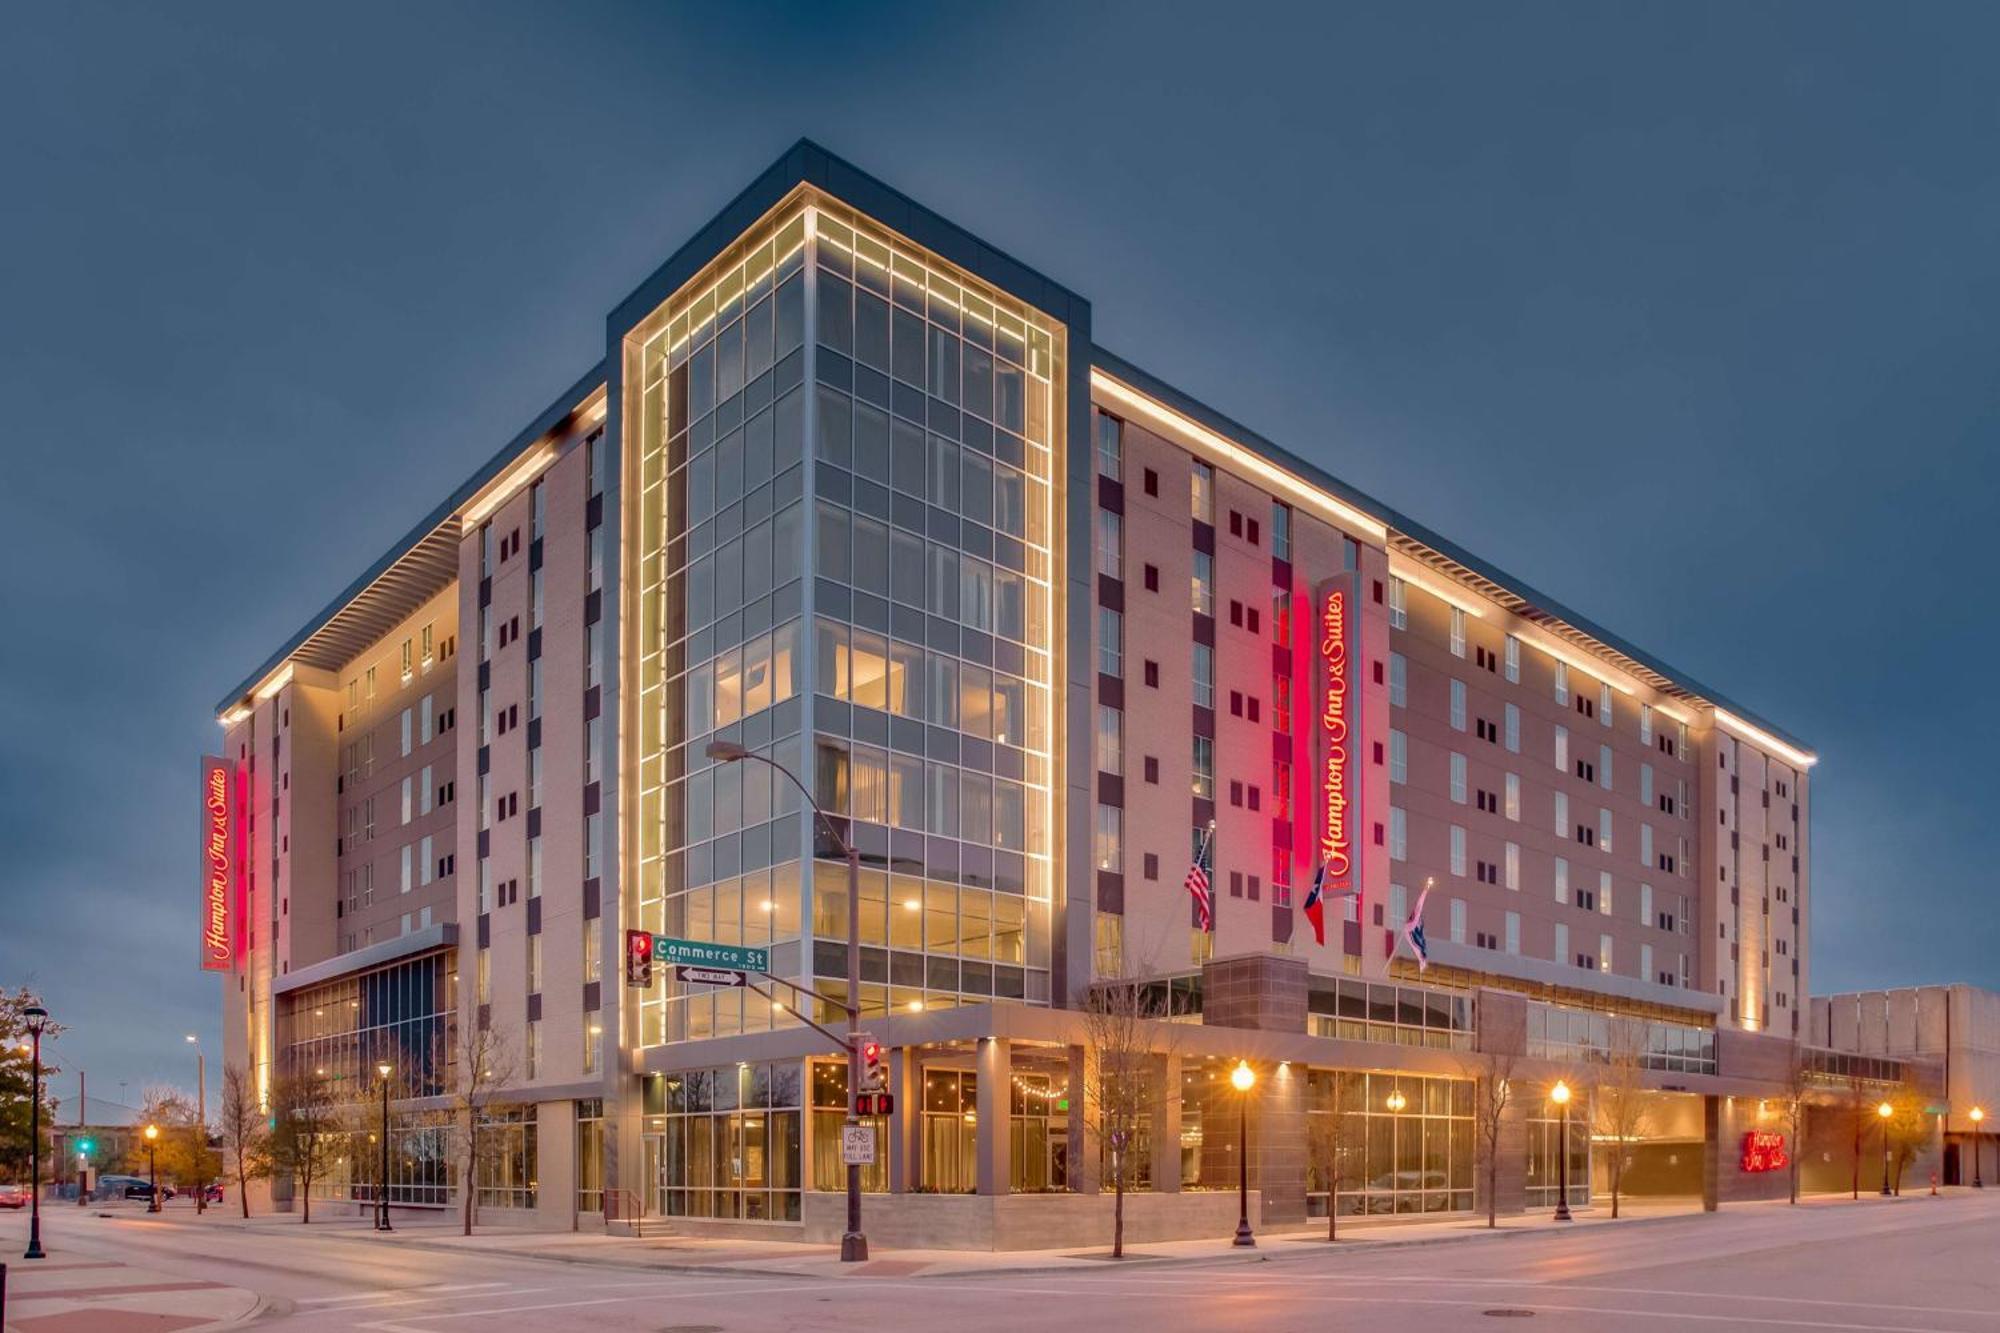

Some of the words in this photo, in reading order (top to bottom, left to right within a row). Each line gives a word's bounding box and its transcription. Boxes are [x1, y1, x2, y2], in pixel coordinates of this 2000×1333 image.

[1322, 591, 1345, 662] Suites
[1328, 658, 1346, 677] &
[1323, 676, 1346, 742] Inn
[207, 768, 226, 816] Suites
[1321, 745, 1349, 876] Hampton
[208, 826, 229, 871] Inn
[206, 871, 230, 960] Hampton
[657, 940, 739, 962] Commerce
[747, 950, 763, 965] St
